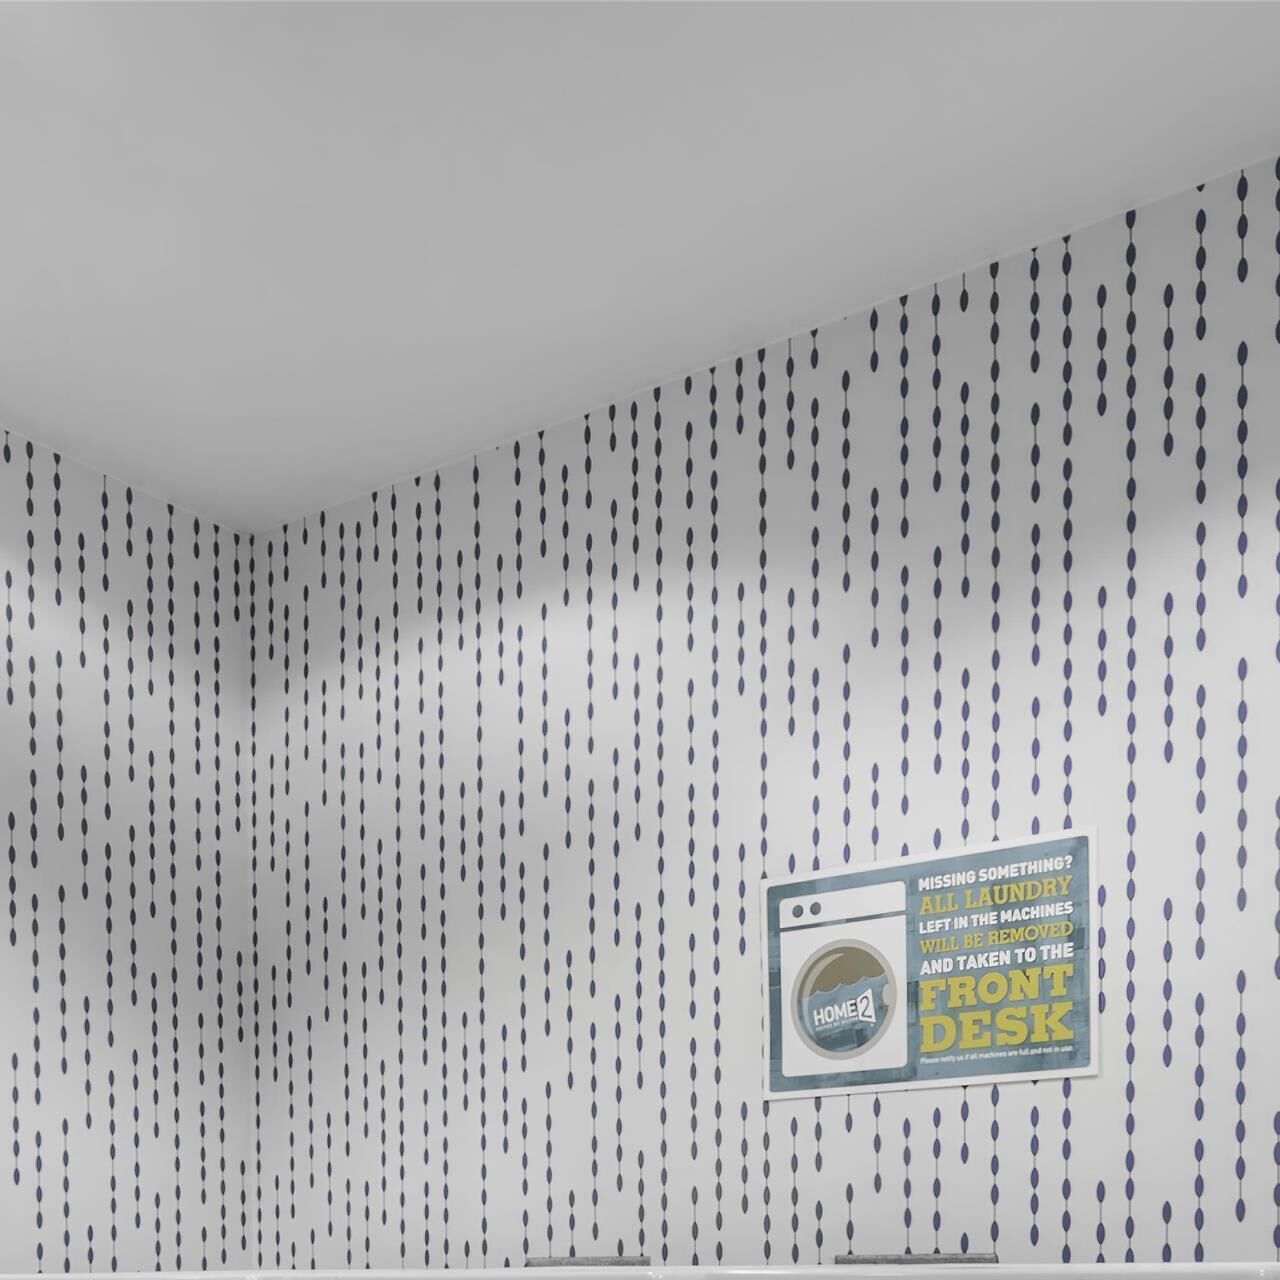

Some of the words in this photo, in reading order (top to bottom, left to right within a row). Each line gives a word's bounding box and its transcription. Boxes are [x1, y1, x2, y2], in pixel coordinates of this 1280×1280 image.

[919, 871, 976, 891] MISSING
[979, 855, 1073, 882] SOMETHING?
[920, 892, 959, 916] ALL
[965, 875, 1072, 909] LAUNDRY
[920, 918, 951, 934] LEFT
[954, 916, 968, 929] IN
[971, 912, 998, 926] THE
[1001, 901, 1073, 922] MACHINES
[920, 936, 959, 954] WILL
[964, 933, 983, 948] BE
[988, 921, 1074, 945] REMOVED
[920, 957, 953, 975] AND
[957, 950, 1010, 969] TAKEN
[1015, 947, 1036, 962] TO
[1040, 942, 1074, 960] THE
[920, 963, 1074, 1011] FRONT
[920, 1001, 1074, 1053] DESK
